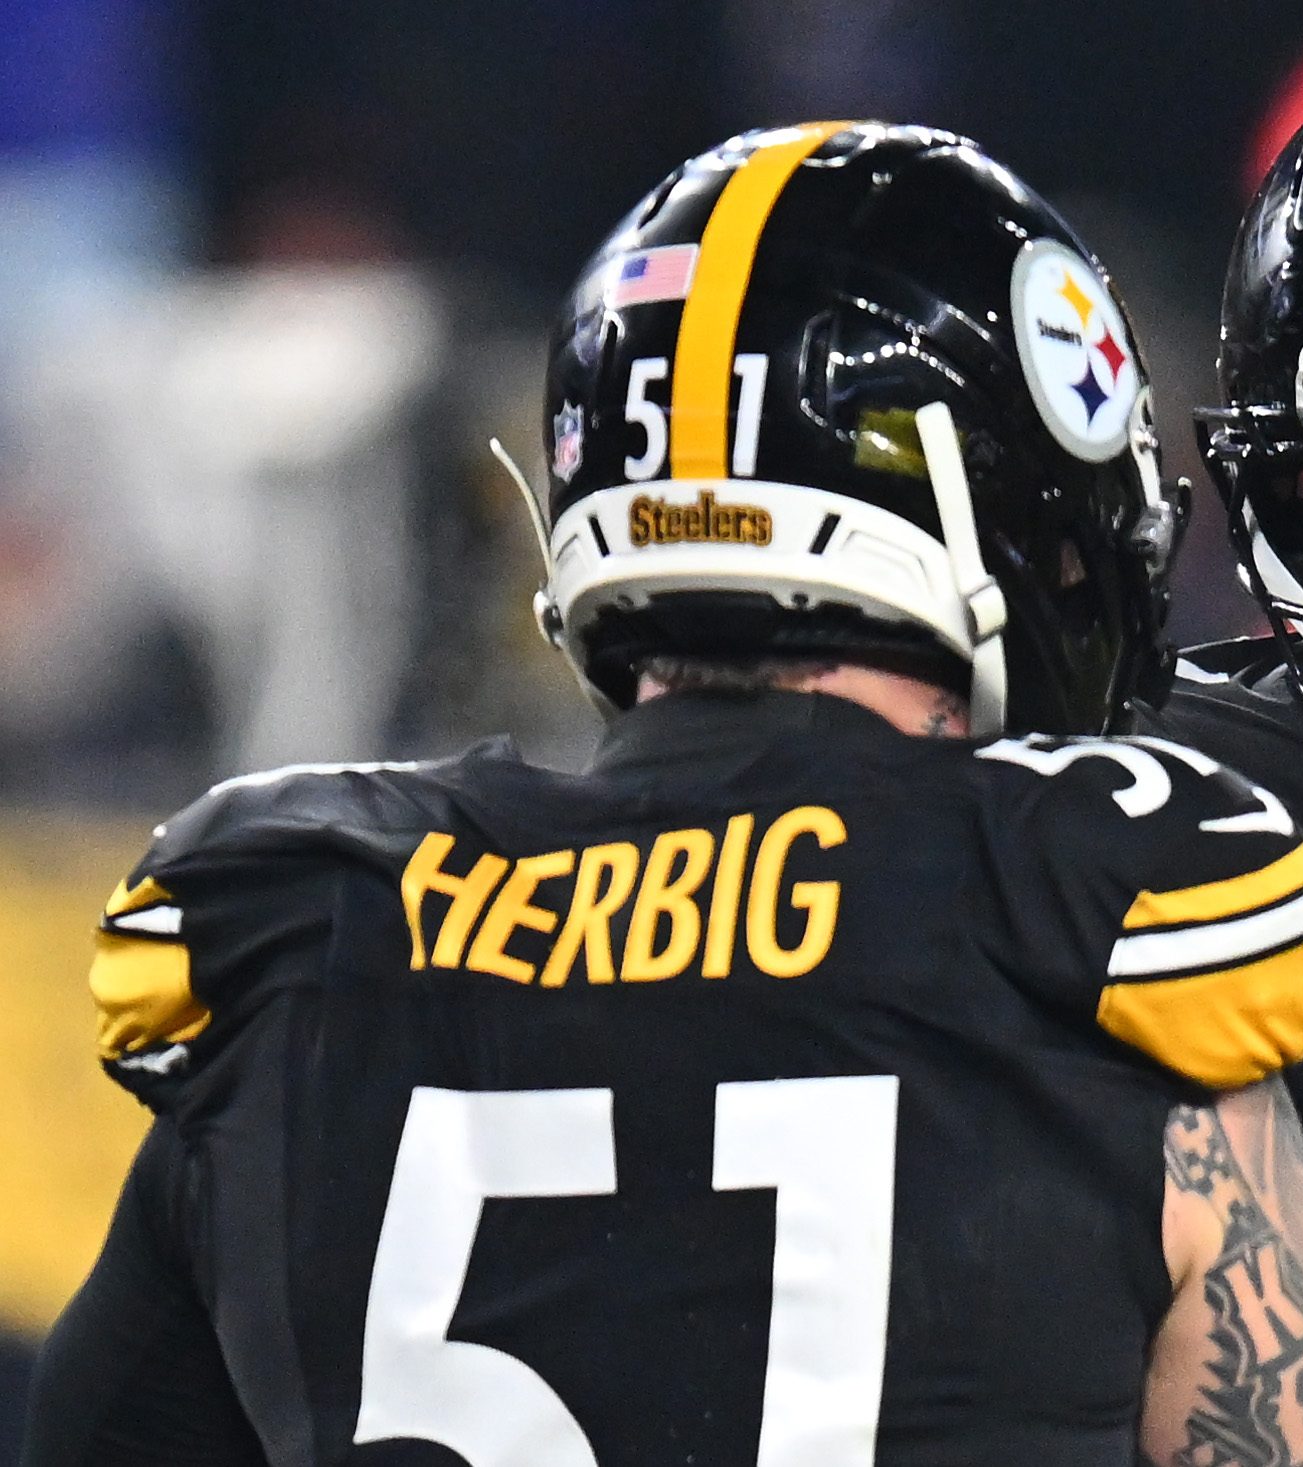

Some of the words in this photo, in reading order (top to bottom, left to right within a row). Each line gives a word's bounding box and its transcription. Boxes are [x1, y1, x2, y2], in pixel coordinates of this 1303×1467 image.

[629, 489, 773, 547] Steelers
[401, 804, 848, 989] HERBIG
[352, 1073, 900, 1467] 51
